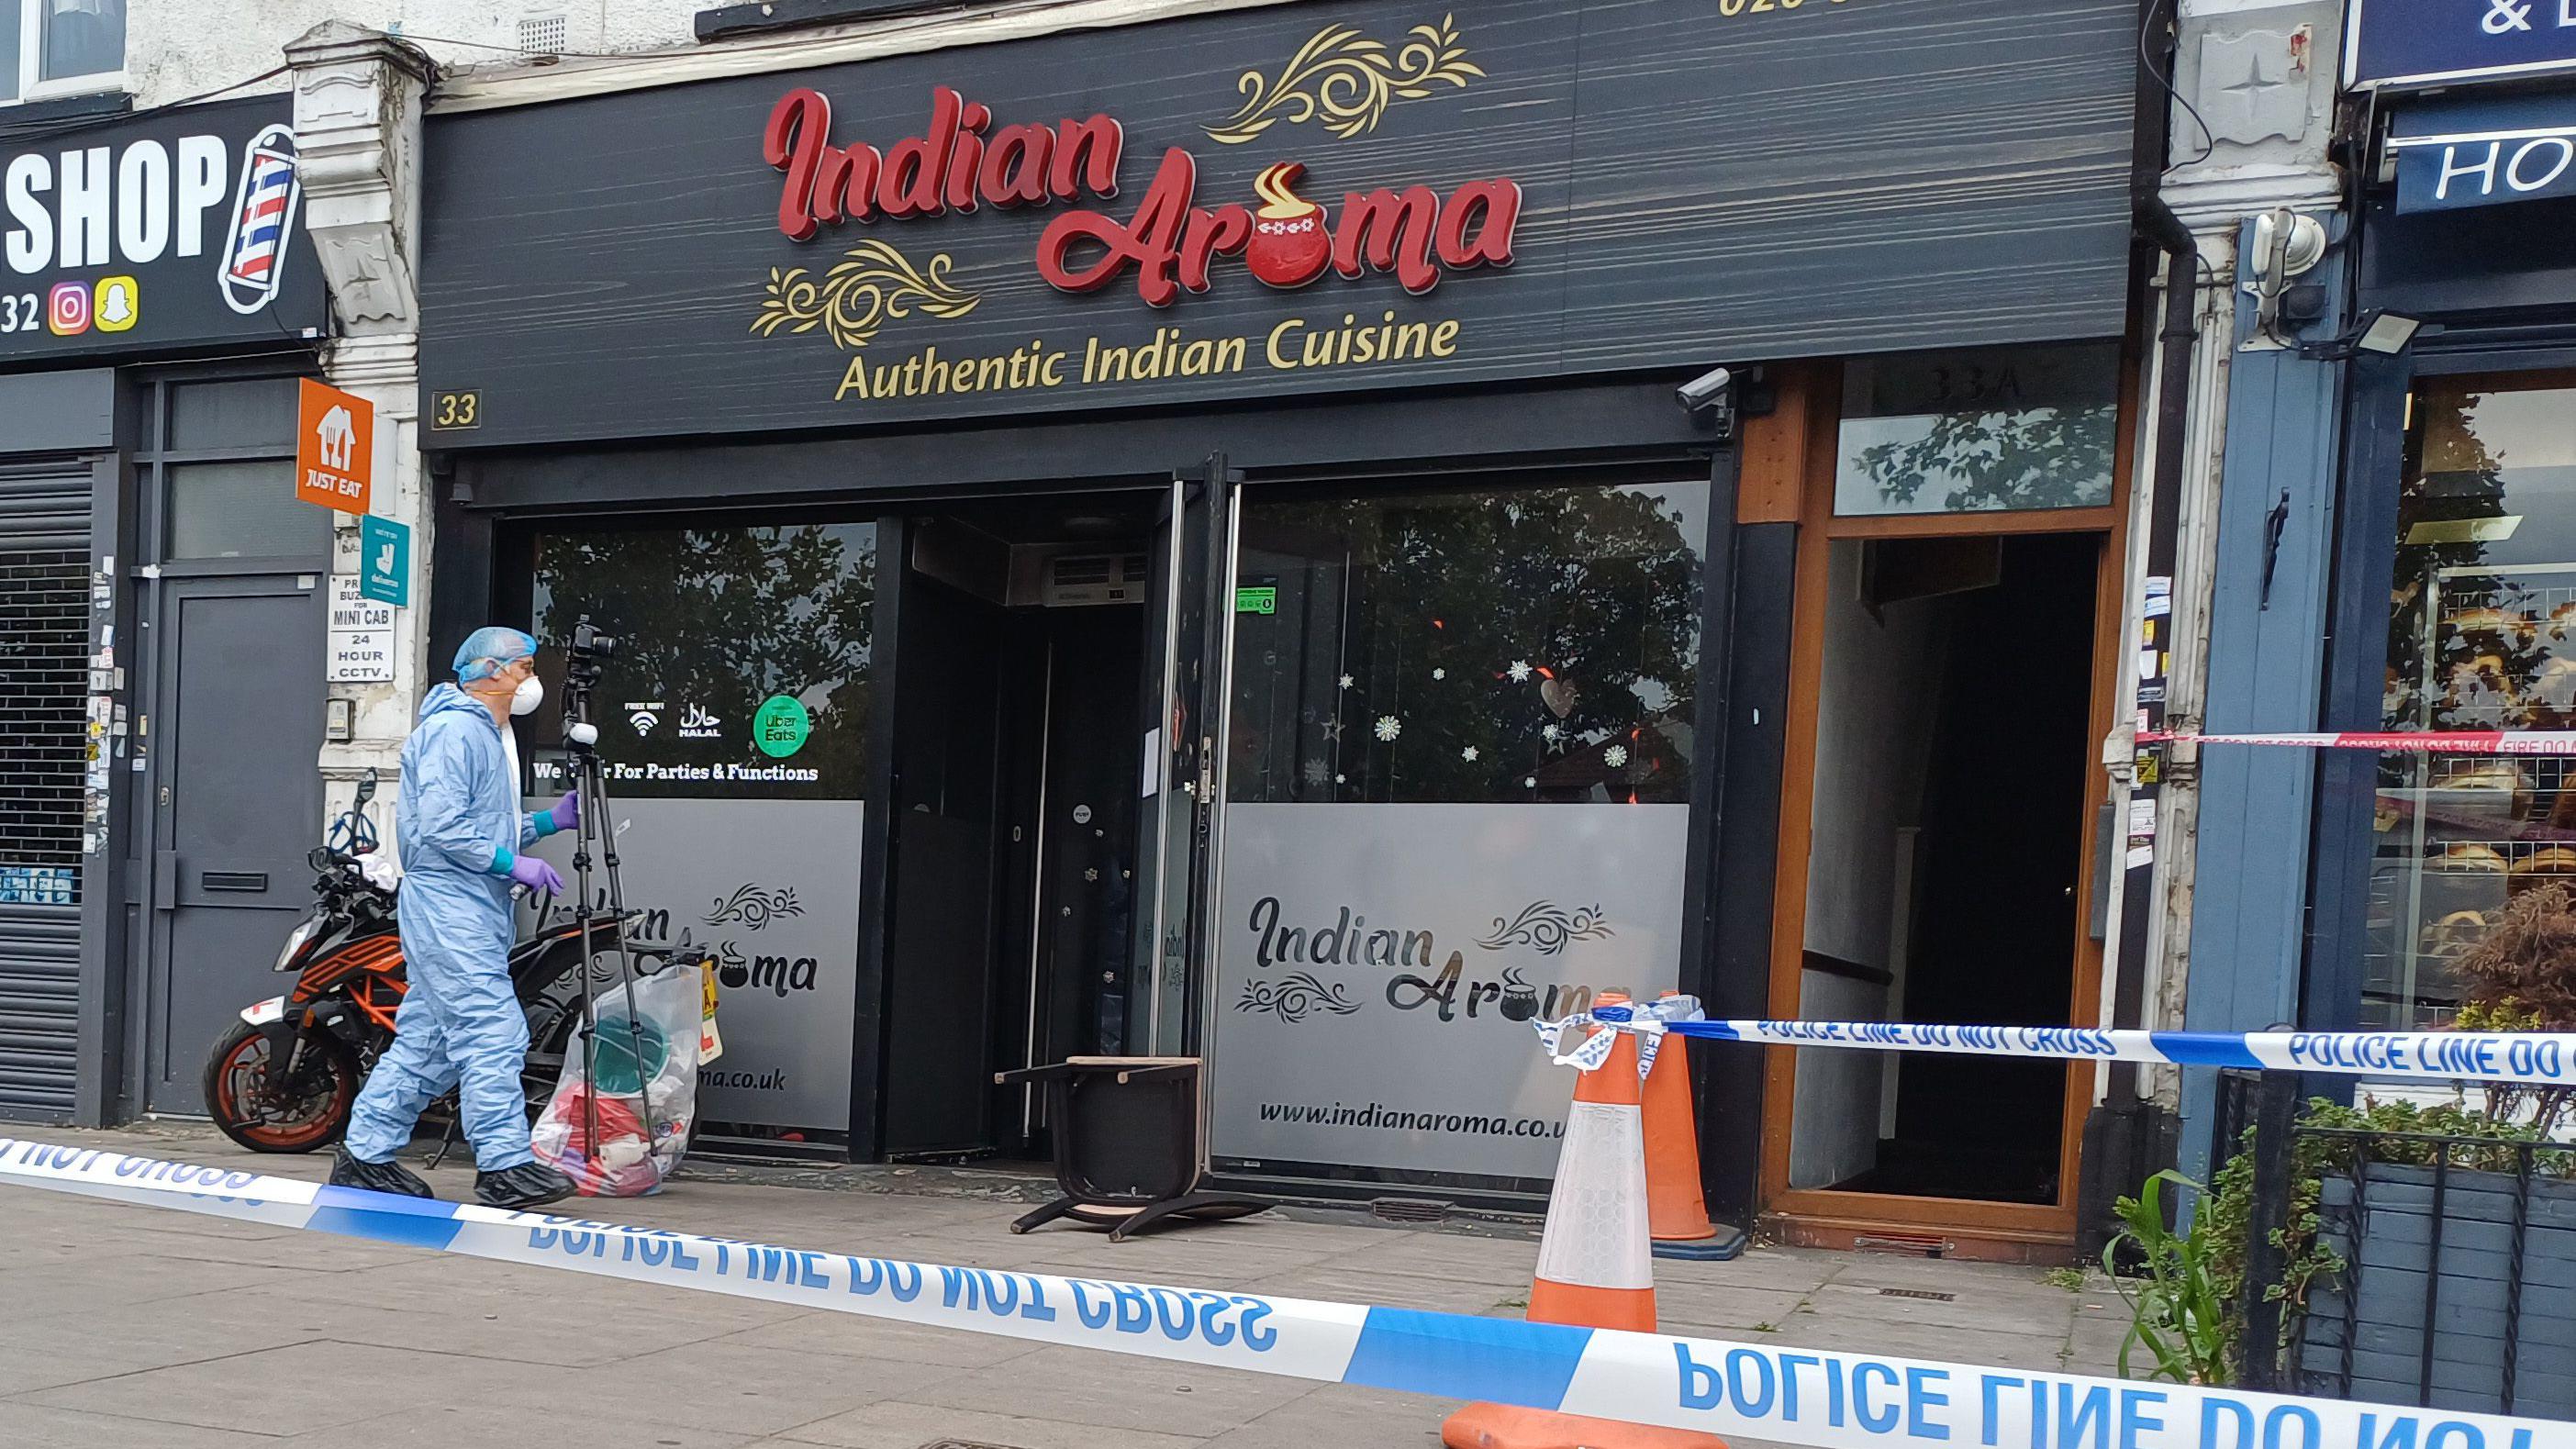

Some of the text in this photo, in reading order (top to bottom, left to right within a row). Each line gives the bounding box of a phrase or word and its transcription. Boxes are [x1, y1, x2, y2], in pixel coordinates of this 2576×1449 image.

[763, 85, 1123, 242] Indian
[6, 135, 228, 274] SHOP
[834, 310, 1461, 402] Authentic Indian Cuisine
[438, 393, 476, 425] 33
[305, 468, 362, 498] JUST EAT
[333, 609, 389, 626] MINI CAB
[351, 635, 370, 645] 24
[338, 651, 384, 662] HOUR
[339, 667, 382, 677] CCTV
[679, 730, 721, 738] HALAL
[764, 715, 797, 727] Uber
[764, 729, 797, 741] Eats
[532, 763, 562, 779] We
[614, 763, 644, 779] For
[646, 763, 710, 780] Parties
[712, 764, 727, 779] &
[727, 764, 819, 781] Functions
[1249, 897, 1434, 968] Indian
[1756, 1020, 1846, 1042] POLICE
[1847, 1021, 1909, 1045] LINE
[2019, 1027, 2118, 1056] CROSS
[2288, 1034, 2561, 1078] POLICE LINE DO
[1259, 1102, 1567, 1139] www.indianaroma.co.u
